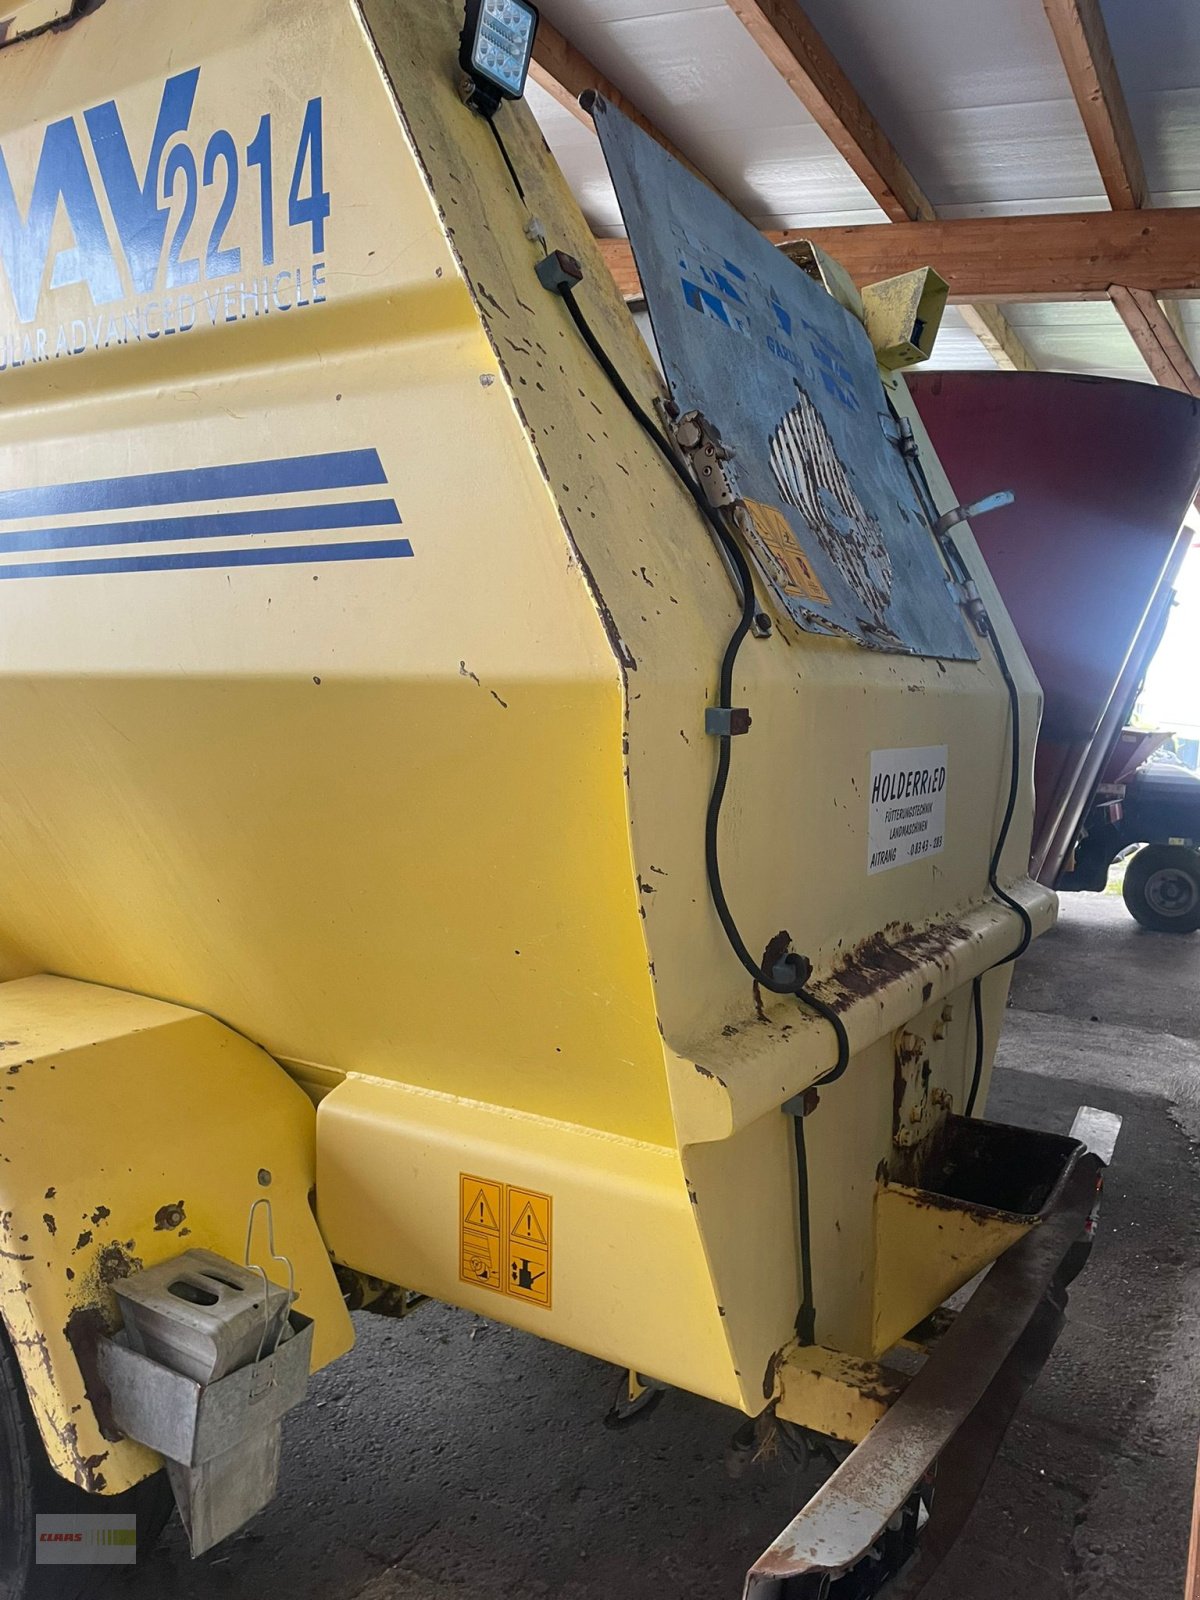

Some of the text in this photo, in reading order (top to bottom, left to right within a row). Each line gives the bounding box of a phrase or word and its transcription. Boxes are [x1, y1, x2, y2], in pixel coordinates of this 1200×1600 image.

[163, 96, 331, 290] 2214
[55, 294, 196, 357] ADVANCED
[203, 262, 327, 325] VEHICLE
[870, 848, 897, 868] AITRANG
[889, 820, 928, 839] LANDMASCHINEN
